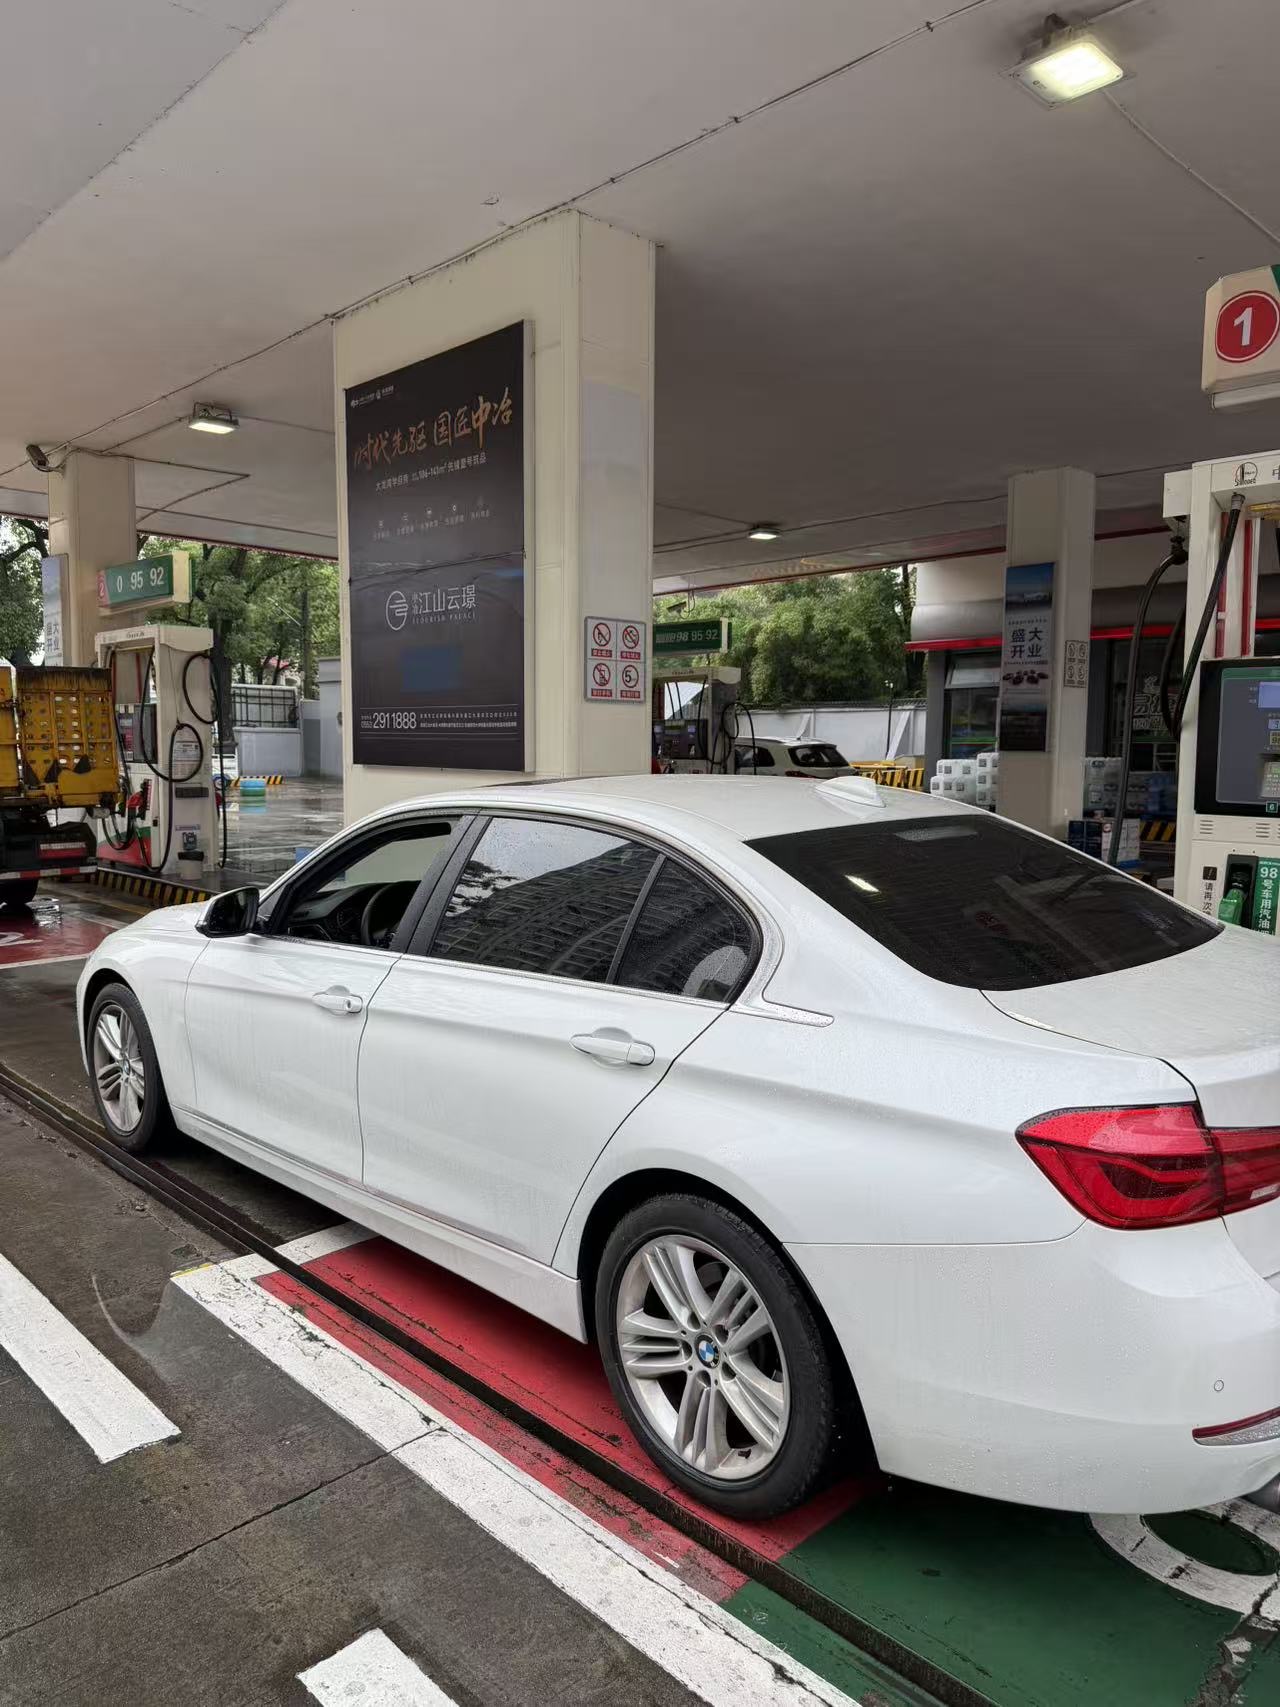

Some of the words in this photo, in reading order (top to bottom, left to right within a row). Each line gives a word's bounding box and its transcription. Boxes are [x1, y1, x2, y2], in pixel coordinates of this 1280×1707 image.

[1233, 307, 1253, 347] 1
[116, 575, 123, 593] 0
[130, 570, 144, 590] 95
[149, 567, 165, 586] 92
[99, 582, 105, 597] 2
[418, 584, 477, 614] 江山云璟
[1011, 627, 1043, 643] 盛大
[1010, 643, 1043, 659] 开业
[624, 669, 632, 683] 5
[372, 711, 417, 729] 2911888
